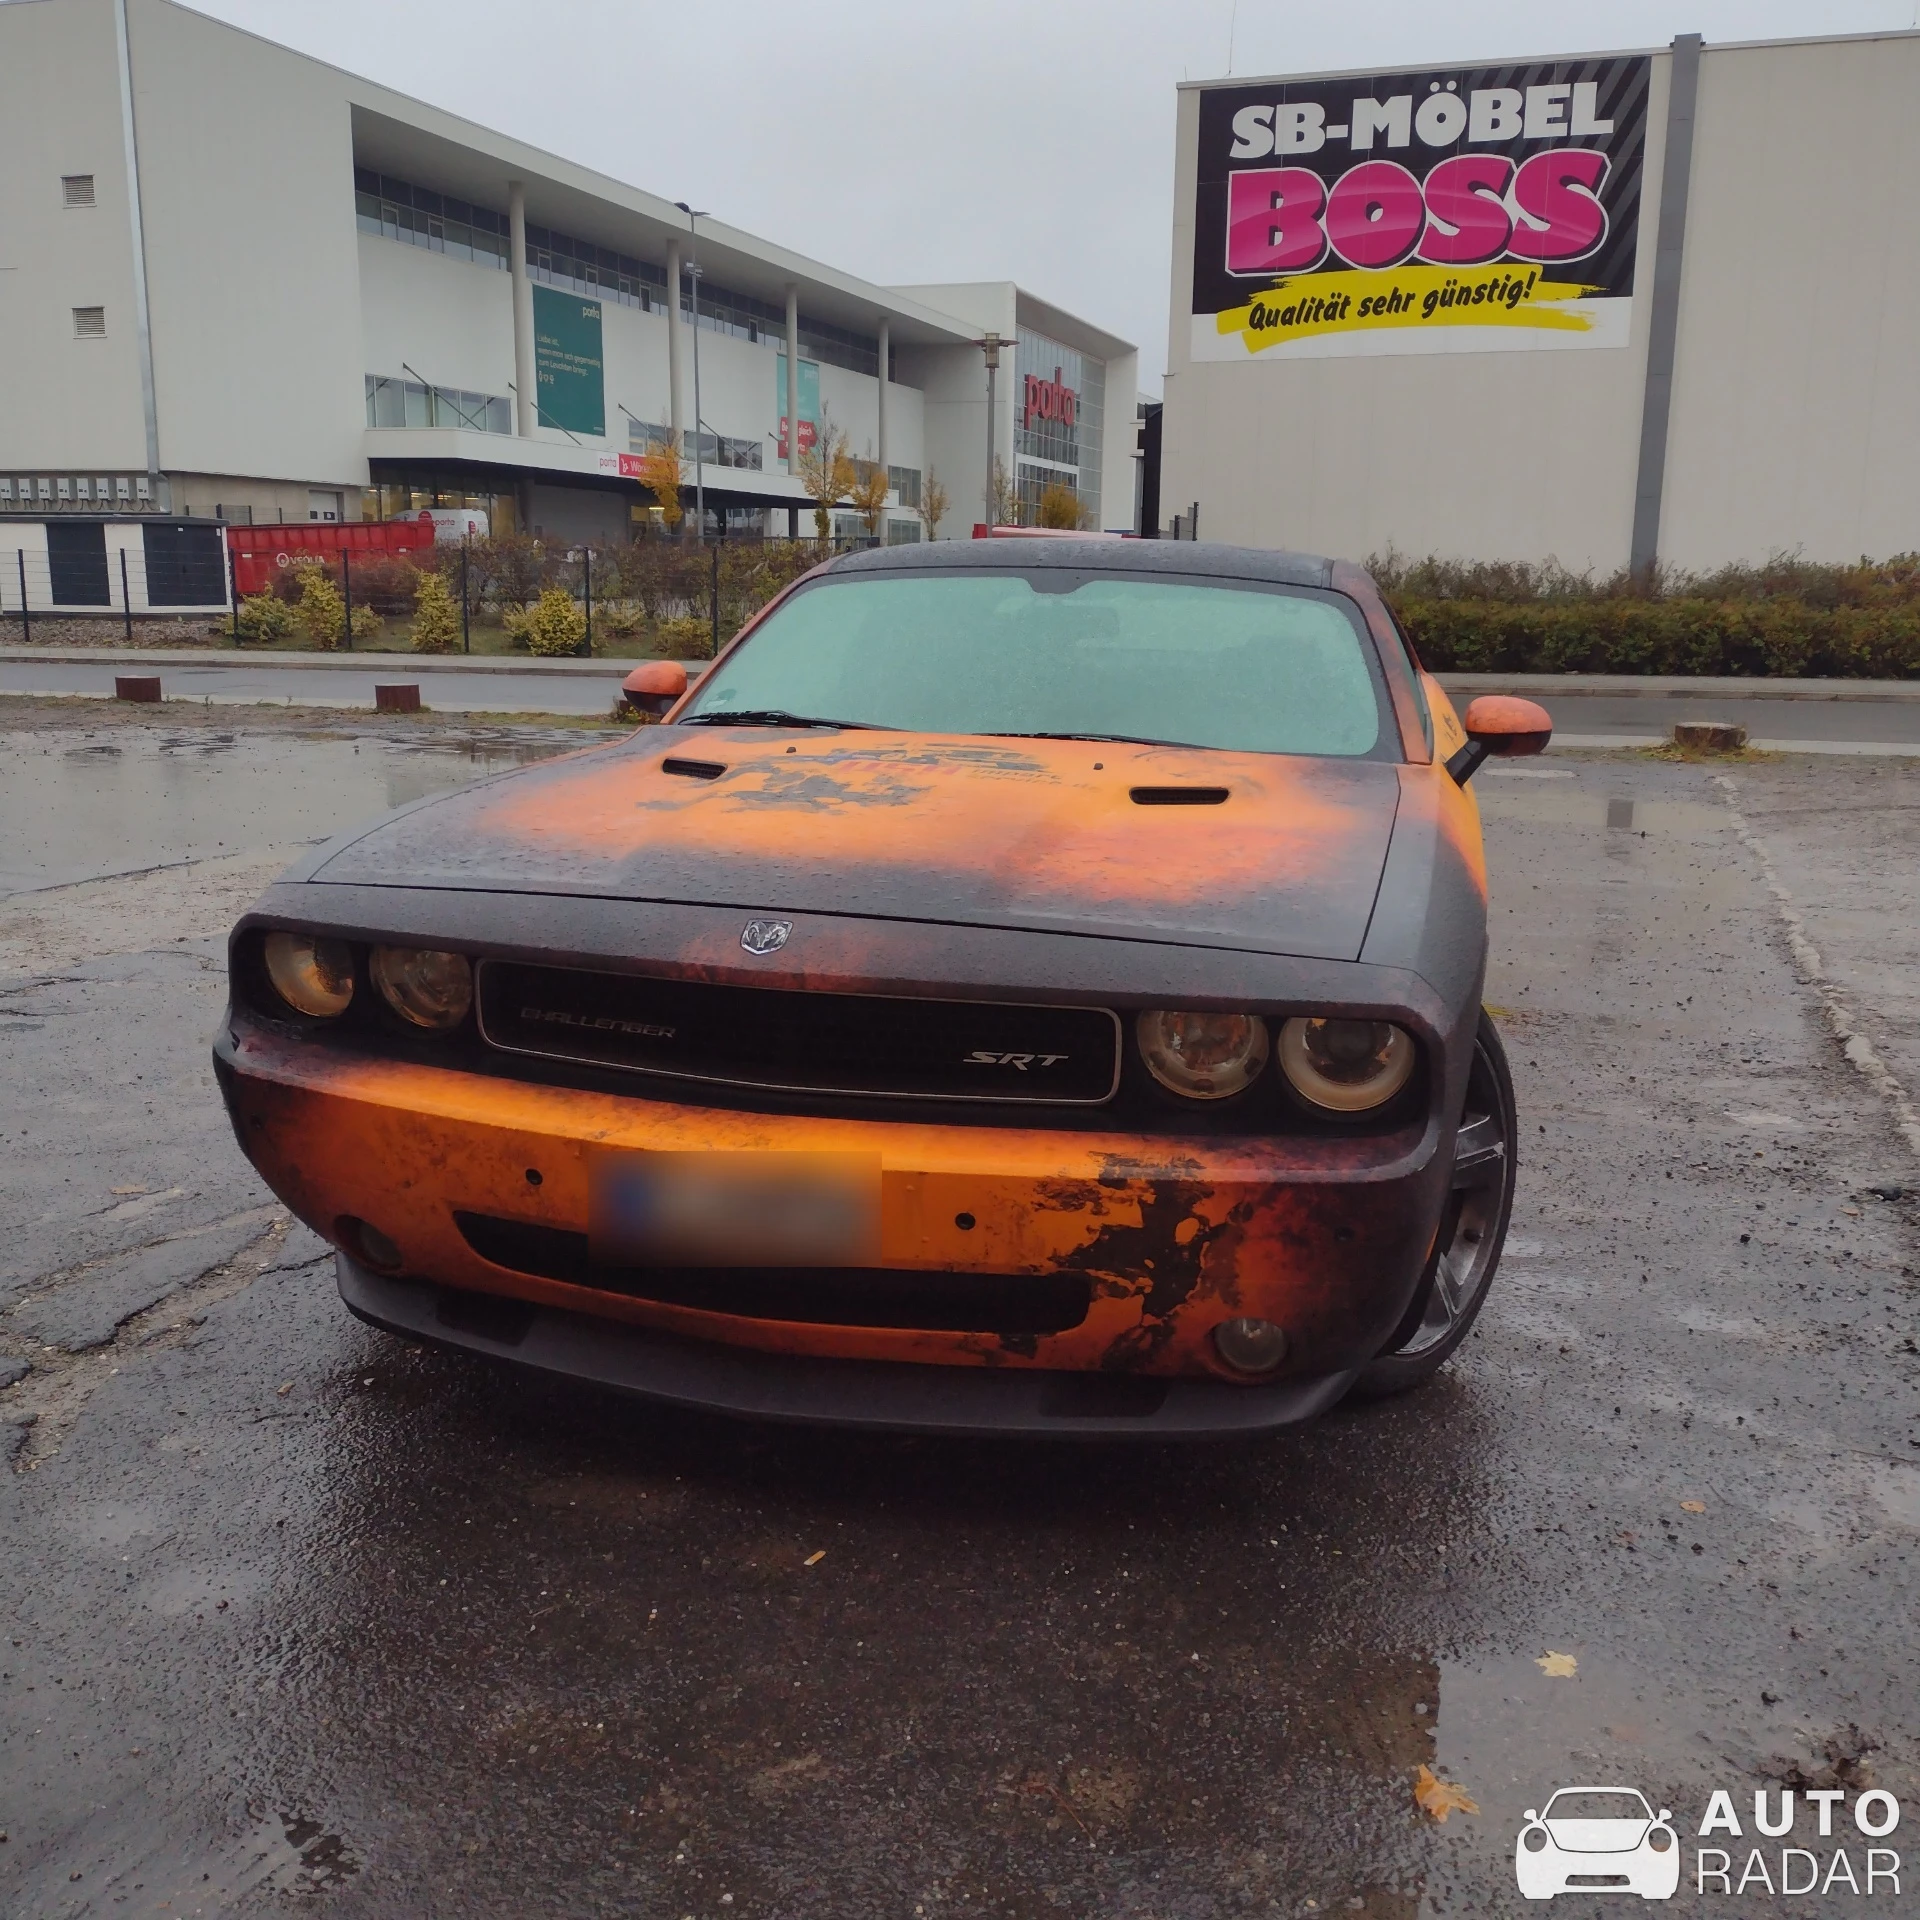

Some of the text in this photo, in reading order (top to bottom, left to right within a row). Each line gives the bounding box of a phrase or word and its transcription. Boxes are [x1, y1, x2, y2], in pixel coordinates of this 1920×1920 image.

[1229, 81, 1614, 158] SB-MÖBEL
[1225, 148, 1611, 277] BOSS
[583, 305, 600, 319] porta
[1248, 270, 1539, 332] Qualität sehr günstig!
[1024, 366, 1075, 430] porta
[600, 456, 617, 468] porta
[520, 1007, 677, 1038] CHALLENGER
[962, 1051, 1070, 1071] SRT
